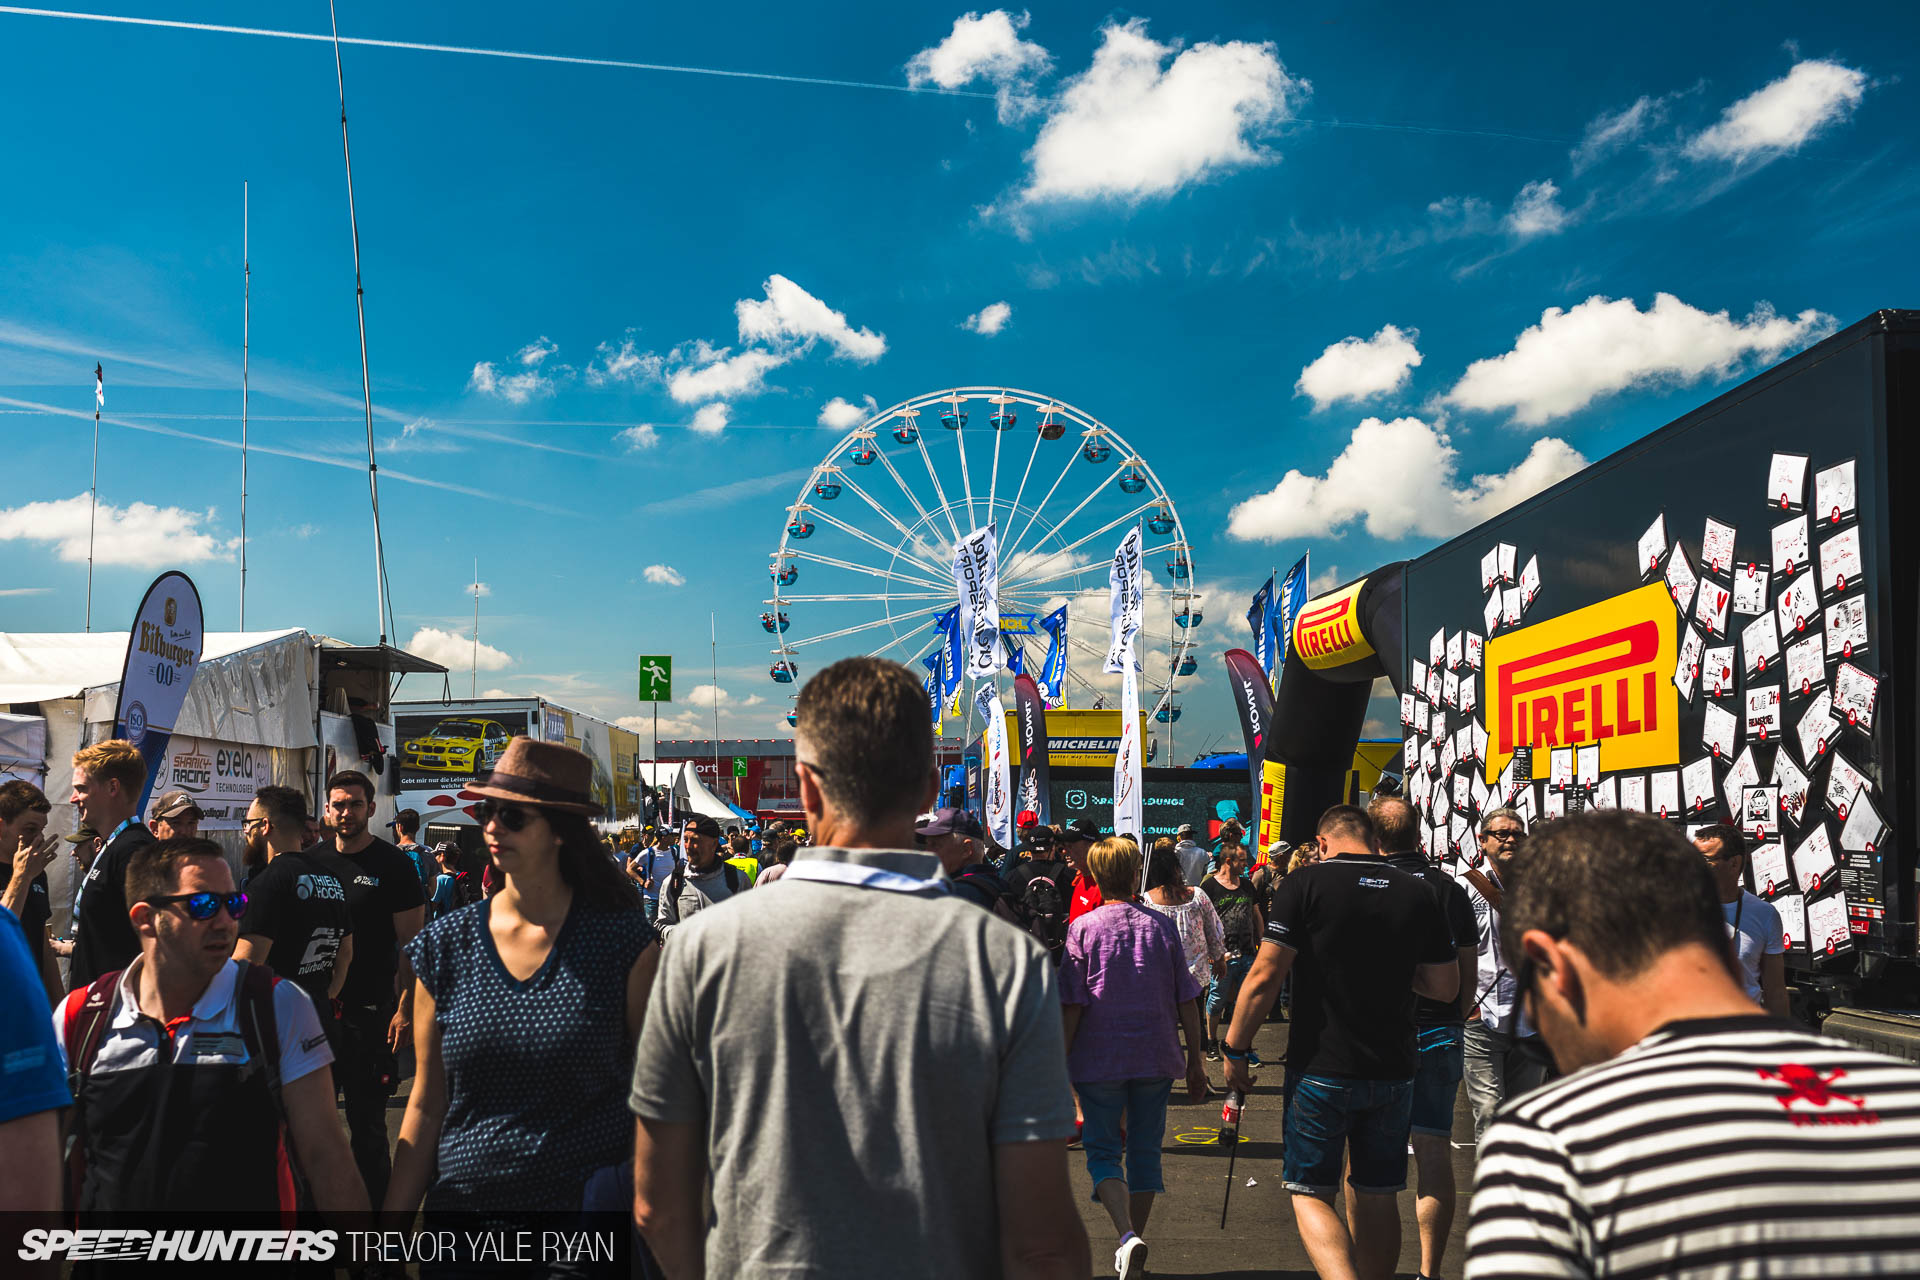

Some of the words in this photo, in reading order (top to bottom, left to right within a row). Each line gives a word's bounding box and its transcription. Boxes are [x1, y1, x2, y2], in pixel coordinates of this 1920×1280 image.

[138, 620, 194, 668] Bitburger
[1297, 596, 1356, 658] PIRELLI
[156, 662, 173, 686] 0.0
[1498, 619, 1659, 755] PIRELLI
[172, 769, 211, 784] RACING
[216, 744, 253, 779] exela
[216, 783, 253, 793] TECHNOLOGIES
